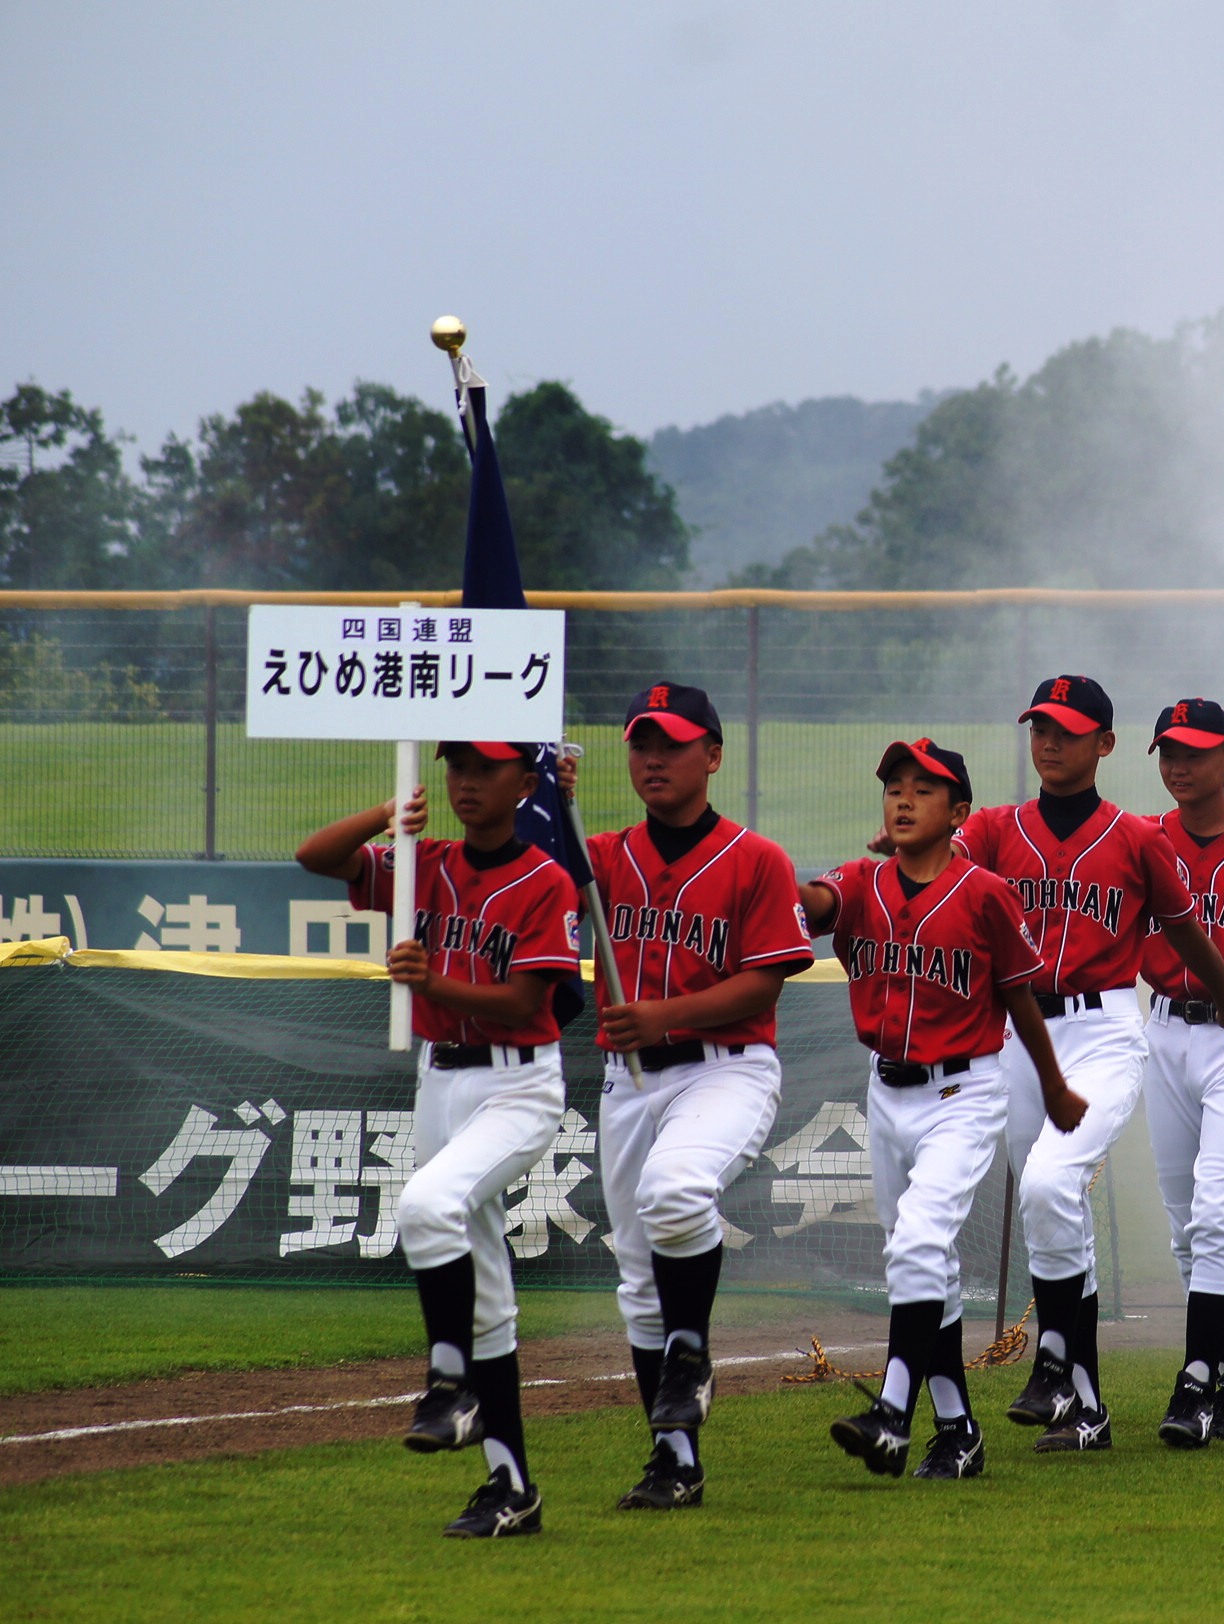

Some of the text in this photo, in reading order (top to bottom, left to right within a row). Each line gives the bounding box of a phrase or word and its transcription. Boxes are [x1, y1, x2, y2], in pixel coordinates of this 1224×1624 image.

[342, 617, 473, 643] 四国連盟
[261, 648, 551, 700] えひめ港南リーグ
[606, 902, 729, 972] OHNAN
[1003, 878, 1124, 937] OHNAN
[847, 934, 972, 1000] KOHNAN
